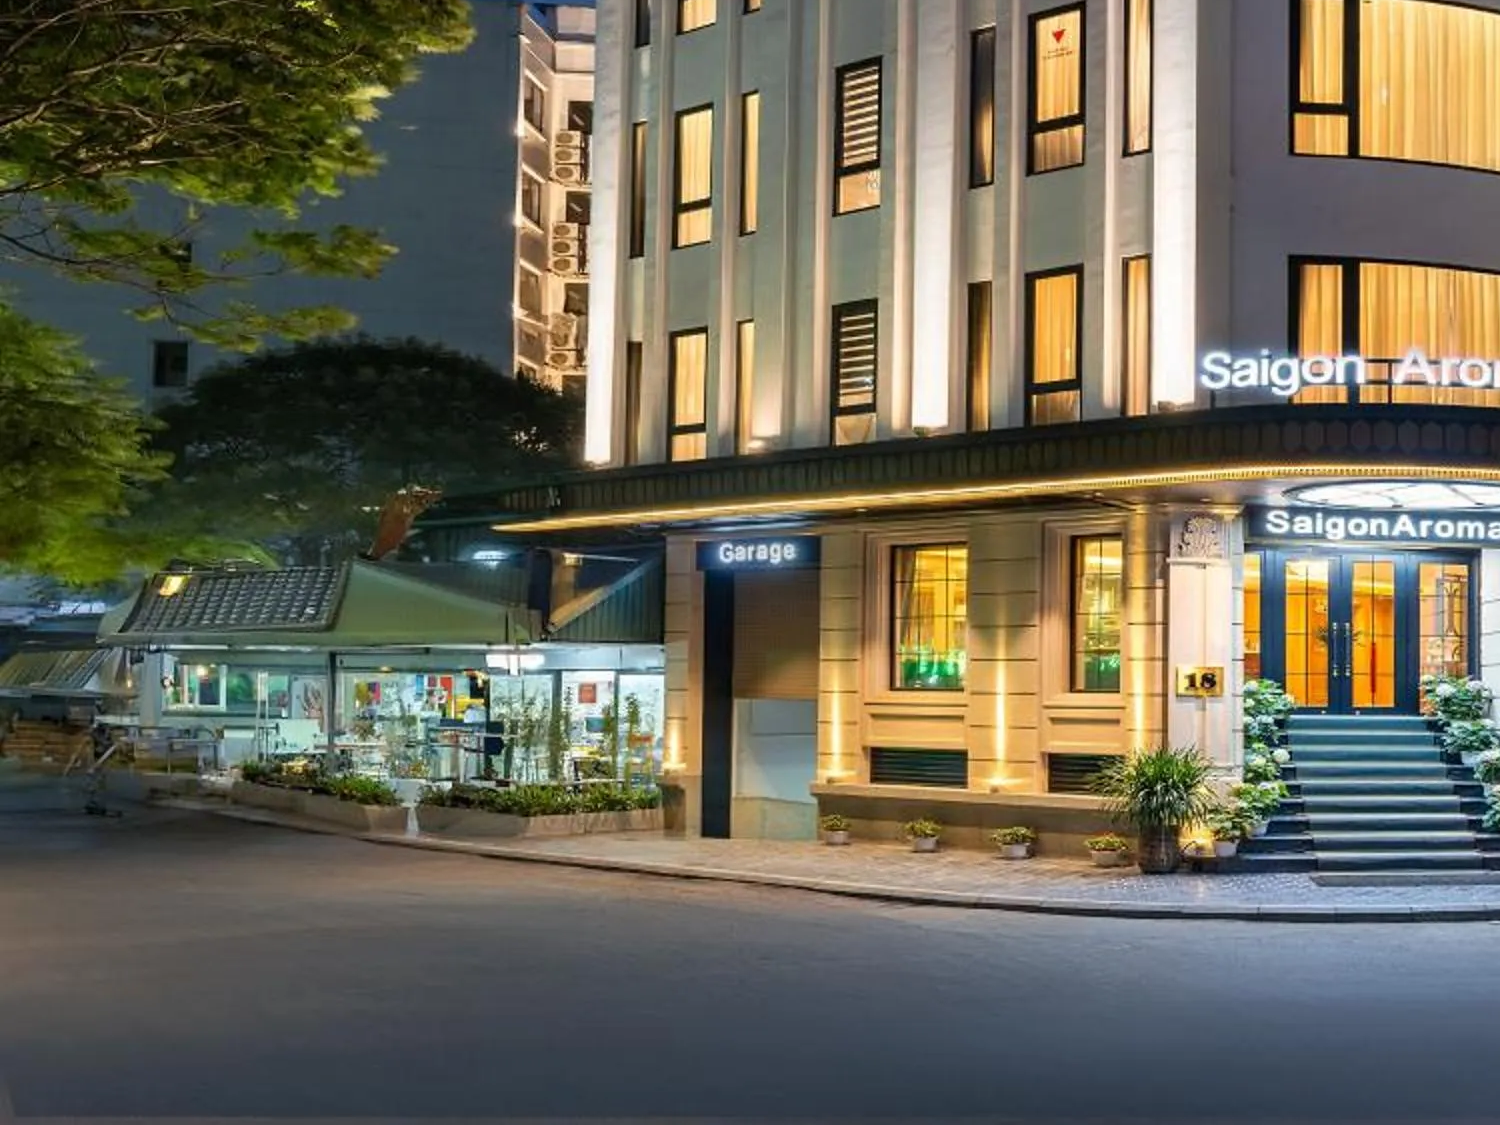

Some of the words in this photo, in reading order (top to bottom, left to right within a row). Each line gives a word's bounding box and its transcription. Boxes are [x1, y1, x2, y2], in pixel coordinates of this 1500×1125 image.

[1200, 349, 1366, 396] Saigon
[719, 541, 796, 564] Garage
[1184, 672, 1217, 691] 18
